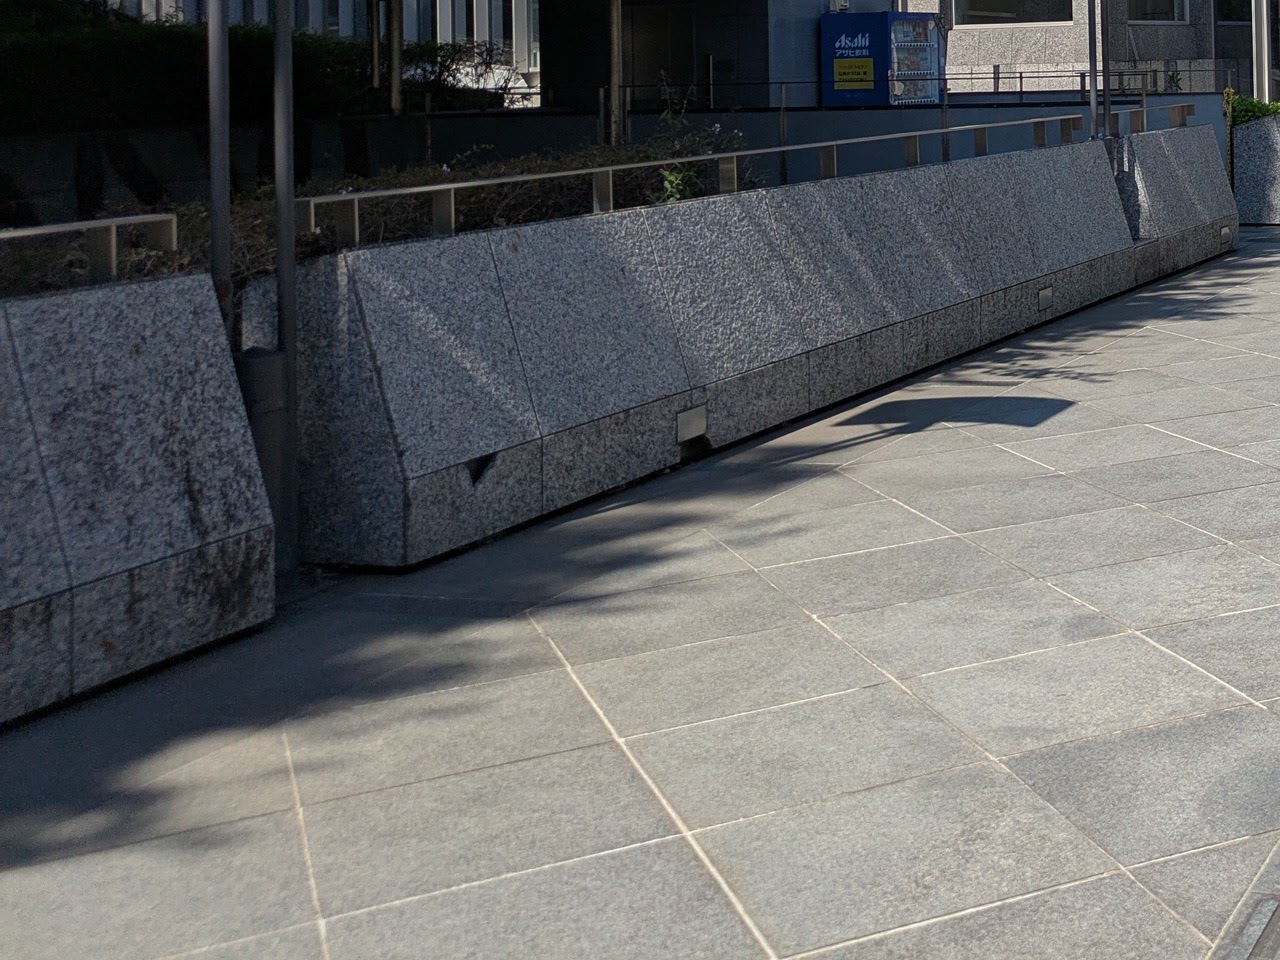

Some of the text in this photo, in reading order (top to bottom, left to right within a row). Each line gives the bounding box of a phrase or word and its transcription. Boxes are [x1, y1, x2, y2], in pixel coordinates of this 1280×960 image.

[834, 32, 870, 49] Asahi
[835, 48, 870, 57] アサヒ飲料
